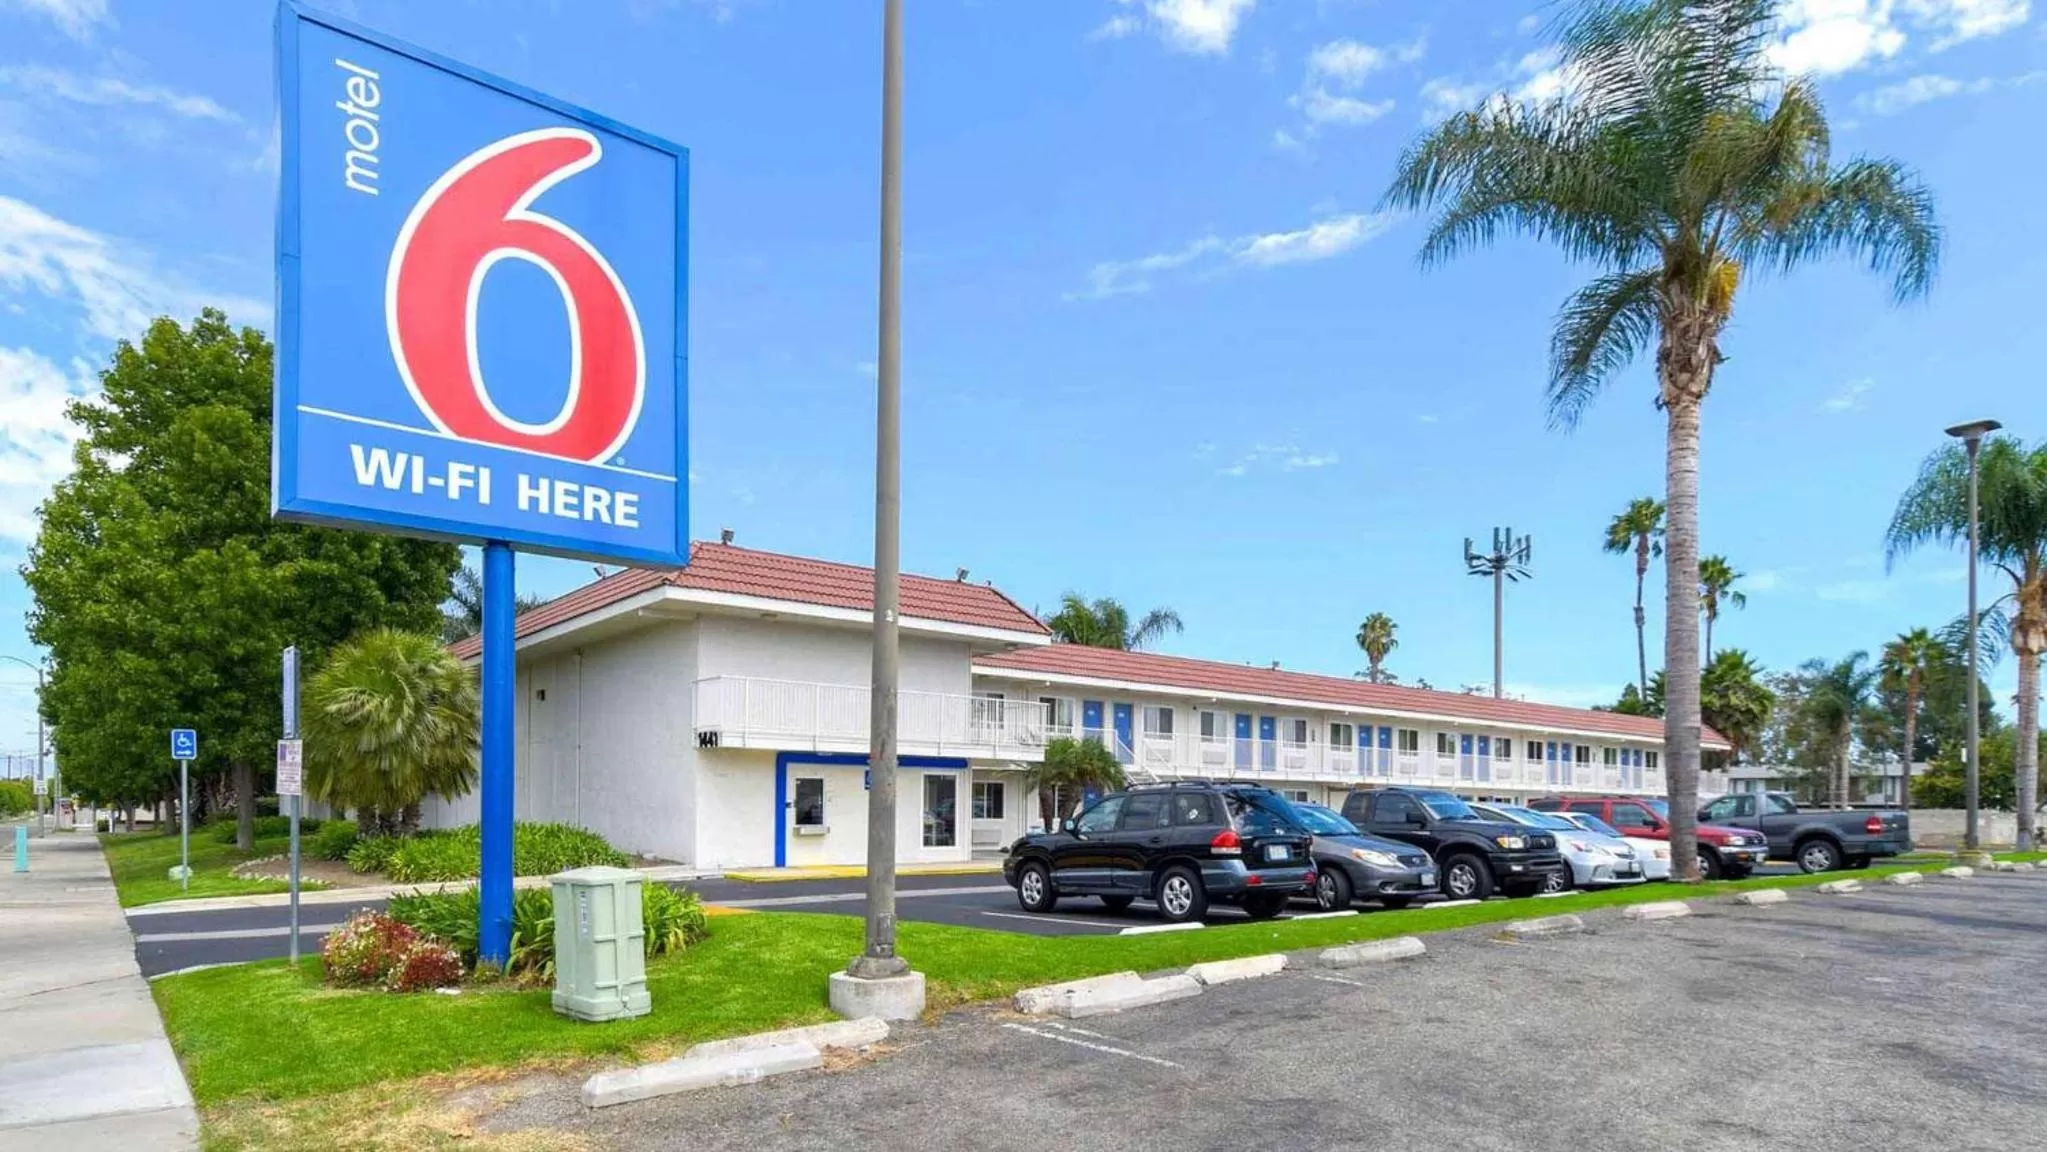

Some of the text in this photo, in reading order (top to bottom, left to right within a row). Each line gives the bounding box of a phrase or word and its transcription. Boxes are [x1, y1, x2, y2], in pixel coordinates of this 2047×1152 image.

[335, 59, 380, 195] motel
[386, 127, 646, 467] 6
[350, 444, 640, 528] WI-FI HERE
